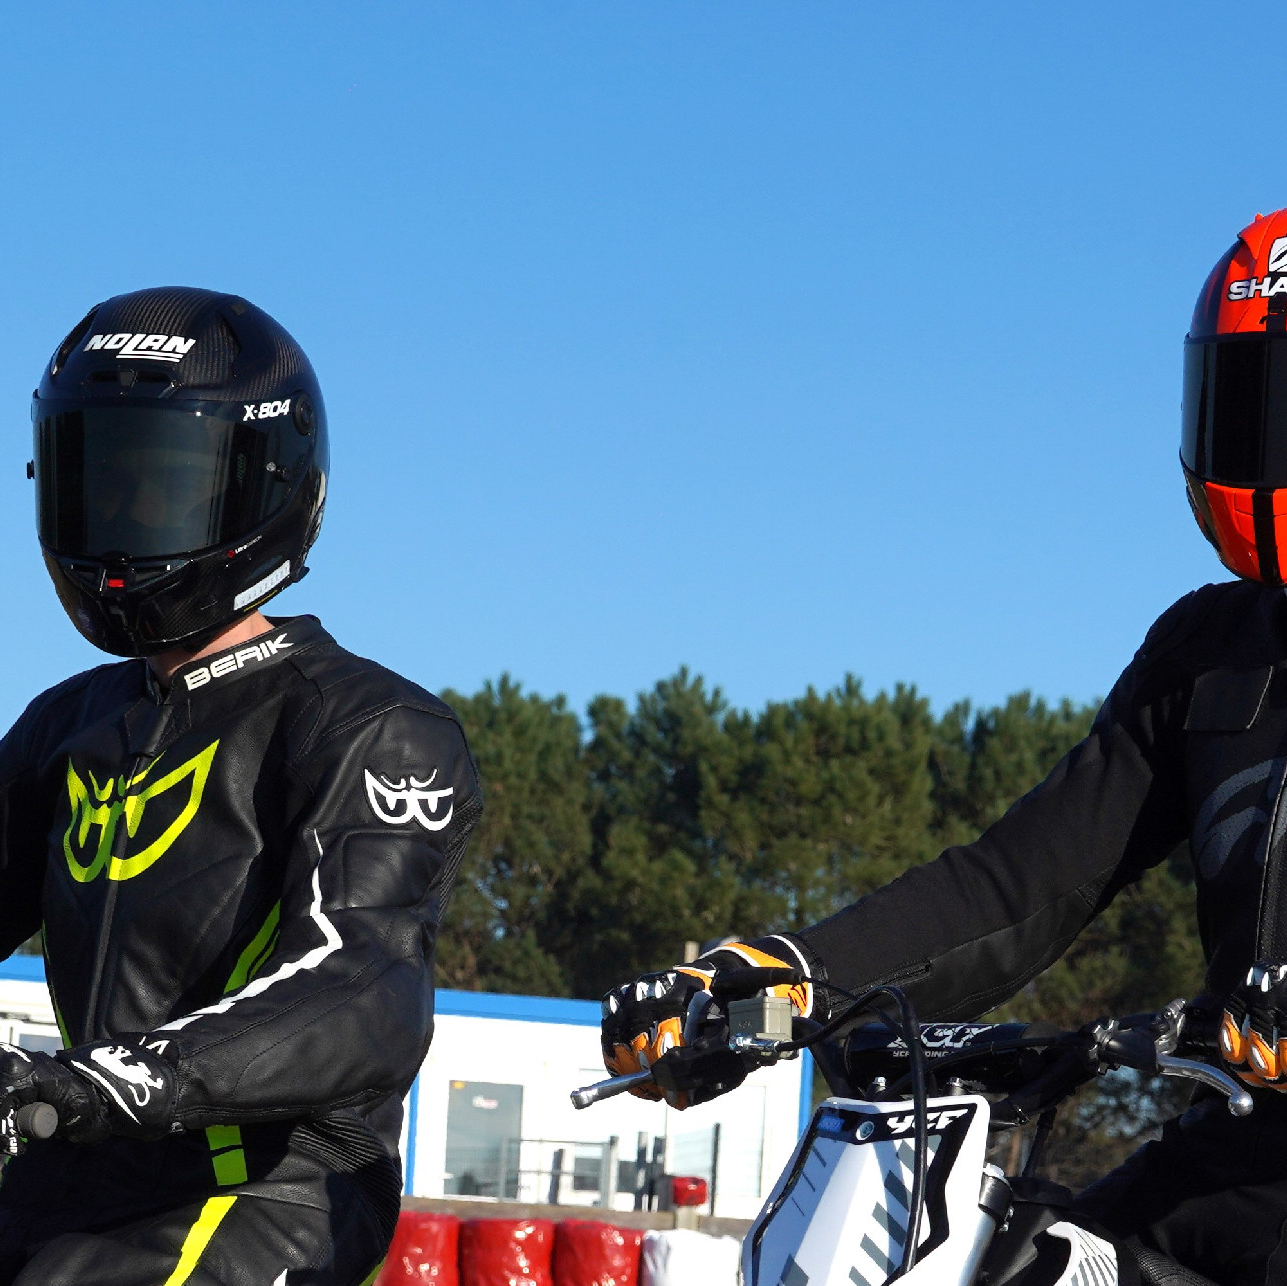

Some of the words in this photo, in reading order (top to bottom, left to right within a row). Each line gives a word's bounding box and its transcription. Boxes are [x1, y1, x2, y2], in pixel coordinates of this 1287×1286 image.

[83, 332, 196, 362] NOLAN
[242, 399, 291, 421] X-804
[183, 632, 295, 692] BERIK
